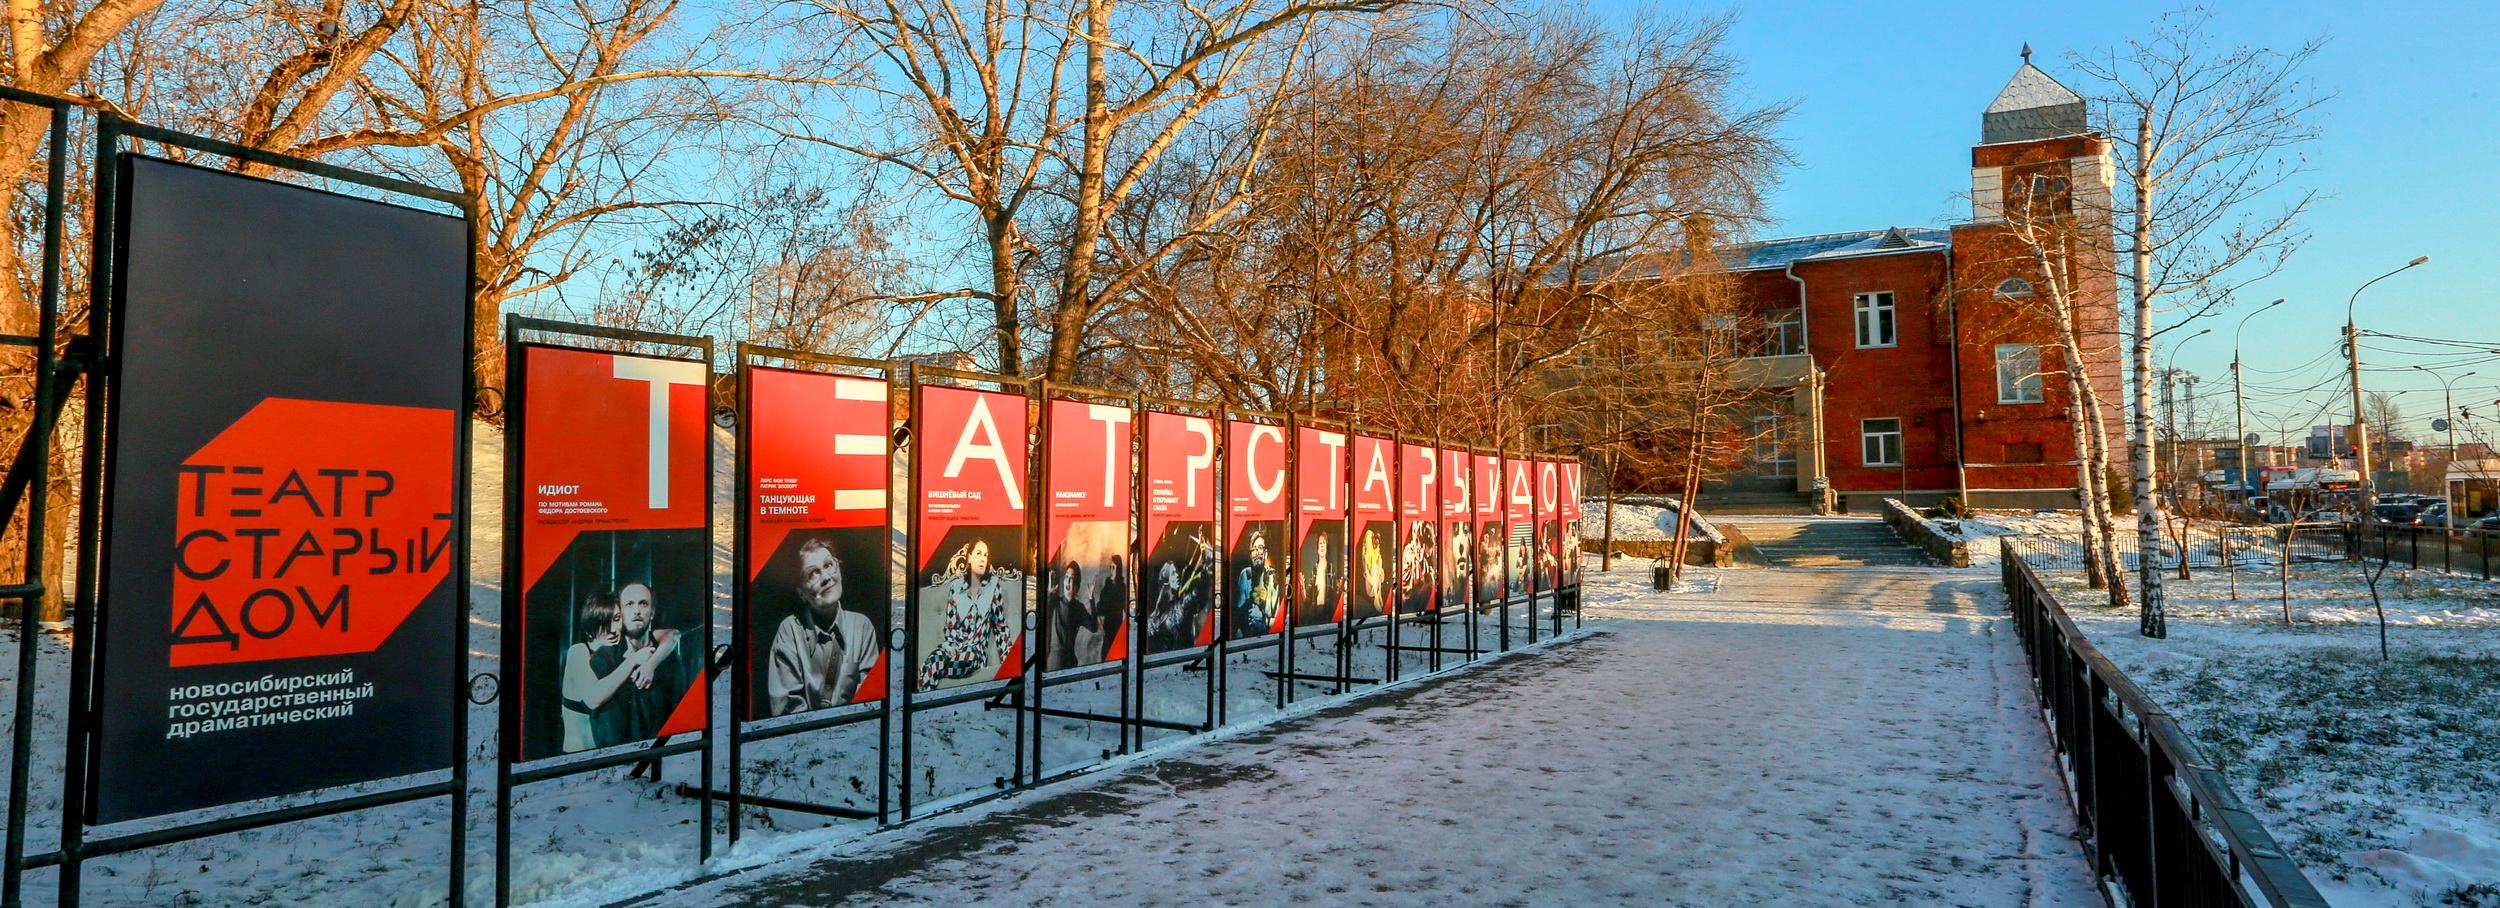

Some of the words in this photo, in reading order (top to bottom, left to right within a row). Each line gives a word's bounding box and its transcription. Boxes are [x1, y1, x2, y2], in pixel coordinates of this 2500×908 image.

[613, 354, 707, 509] Т
[943, 392, 1025, 510] А
[1088, 403, 1132, 508] Т
[1186, 416, 1214, 508] Р
[180, 464, 394, 518] ТЕАТР
[538, 485, 580, 497] ИДИОТ
[967, 491, 982, 500] САД
[1246, 424, 1286, 504] С
[1318, 431, 1346, 510] Т
[1363, 439, 1394, 512] А
[1420, 447, 1437, 512] Р
[1453, 450, 1470, 513] Ы
[1511, 462, 1533, 514] Д
[1542, 462, 1558, 513] О
[760, 495, 816, 505] ТАНЦУЮЩАЯ
[760, 506, 767, 515] В
[768, 506, 809, 515] ТЕМНОТЕ
[174, 512, 453, 580] СТАРЫЙ
[170, 585, 349, 652] ДОМ
[168, 668, 354, 702] новосибирский
[168, 682, 375, 720] государственный
[166, 701, 354, 740] драматический
